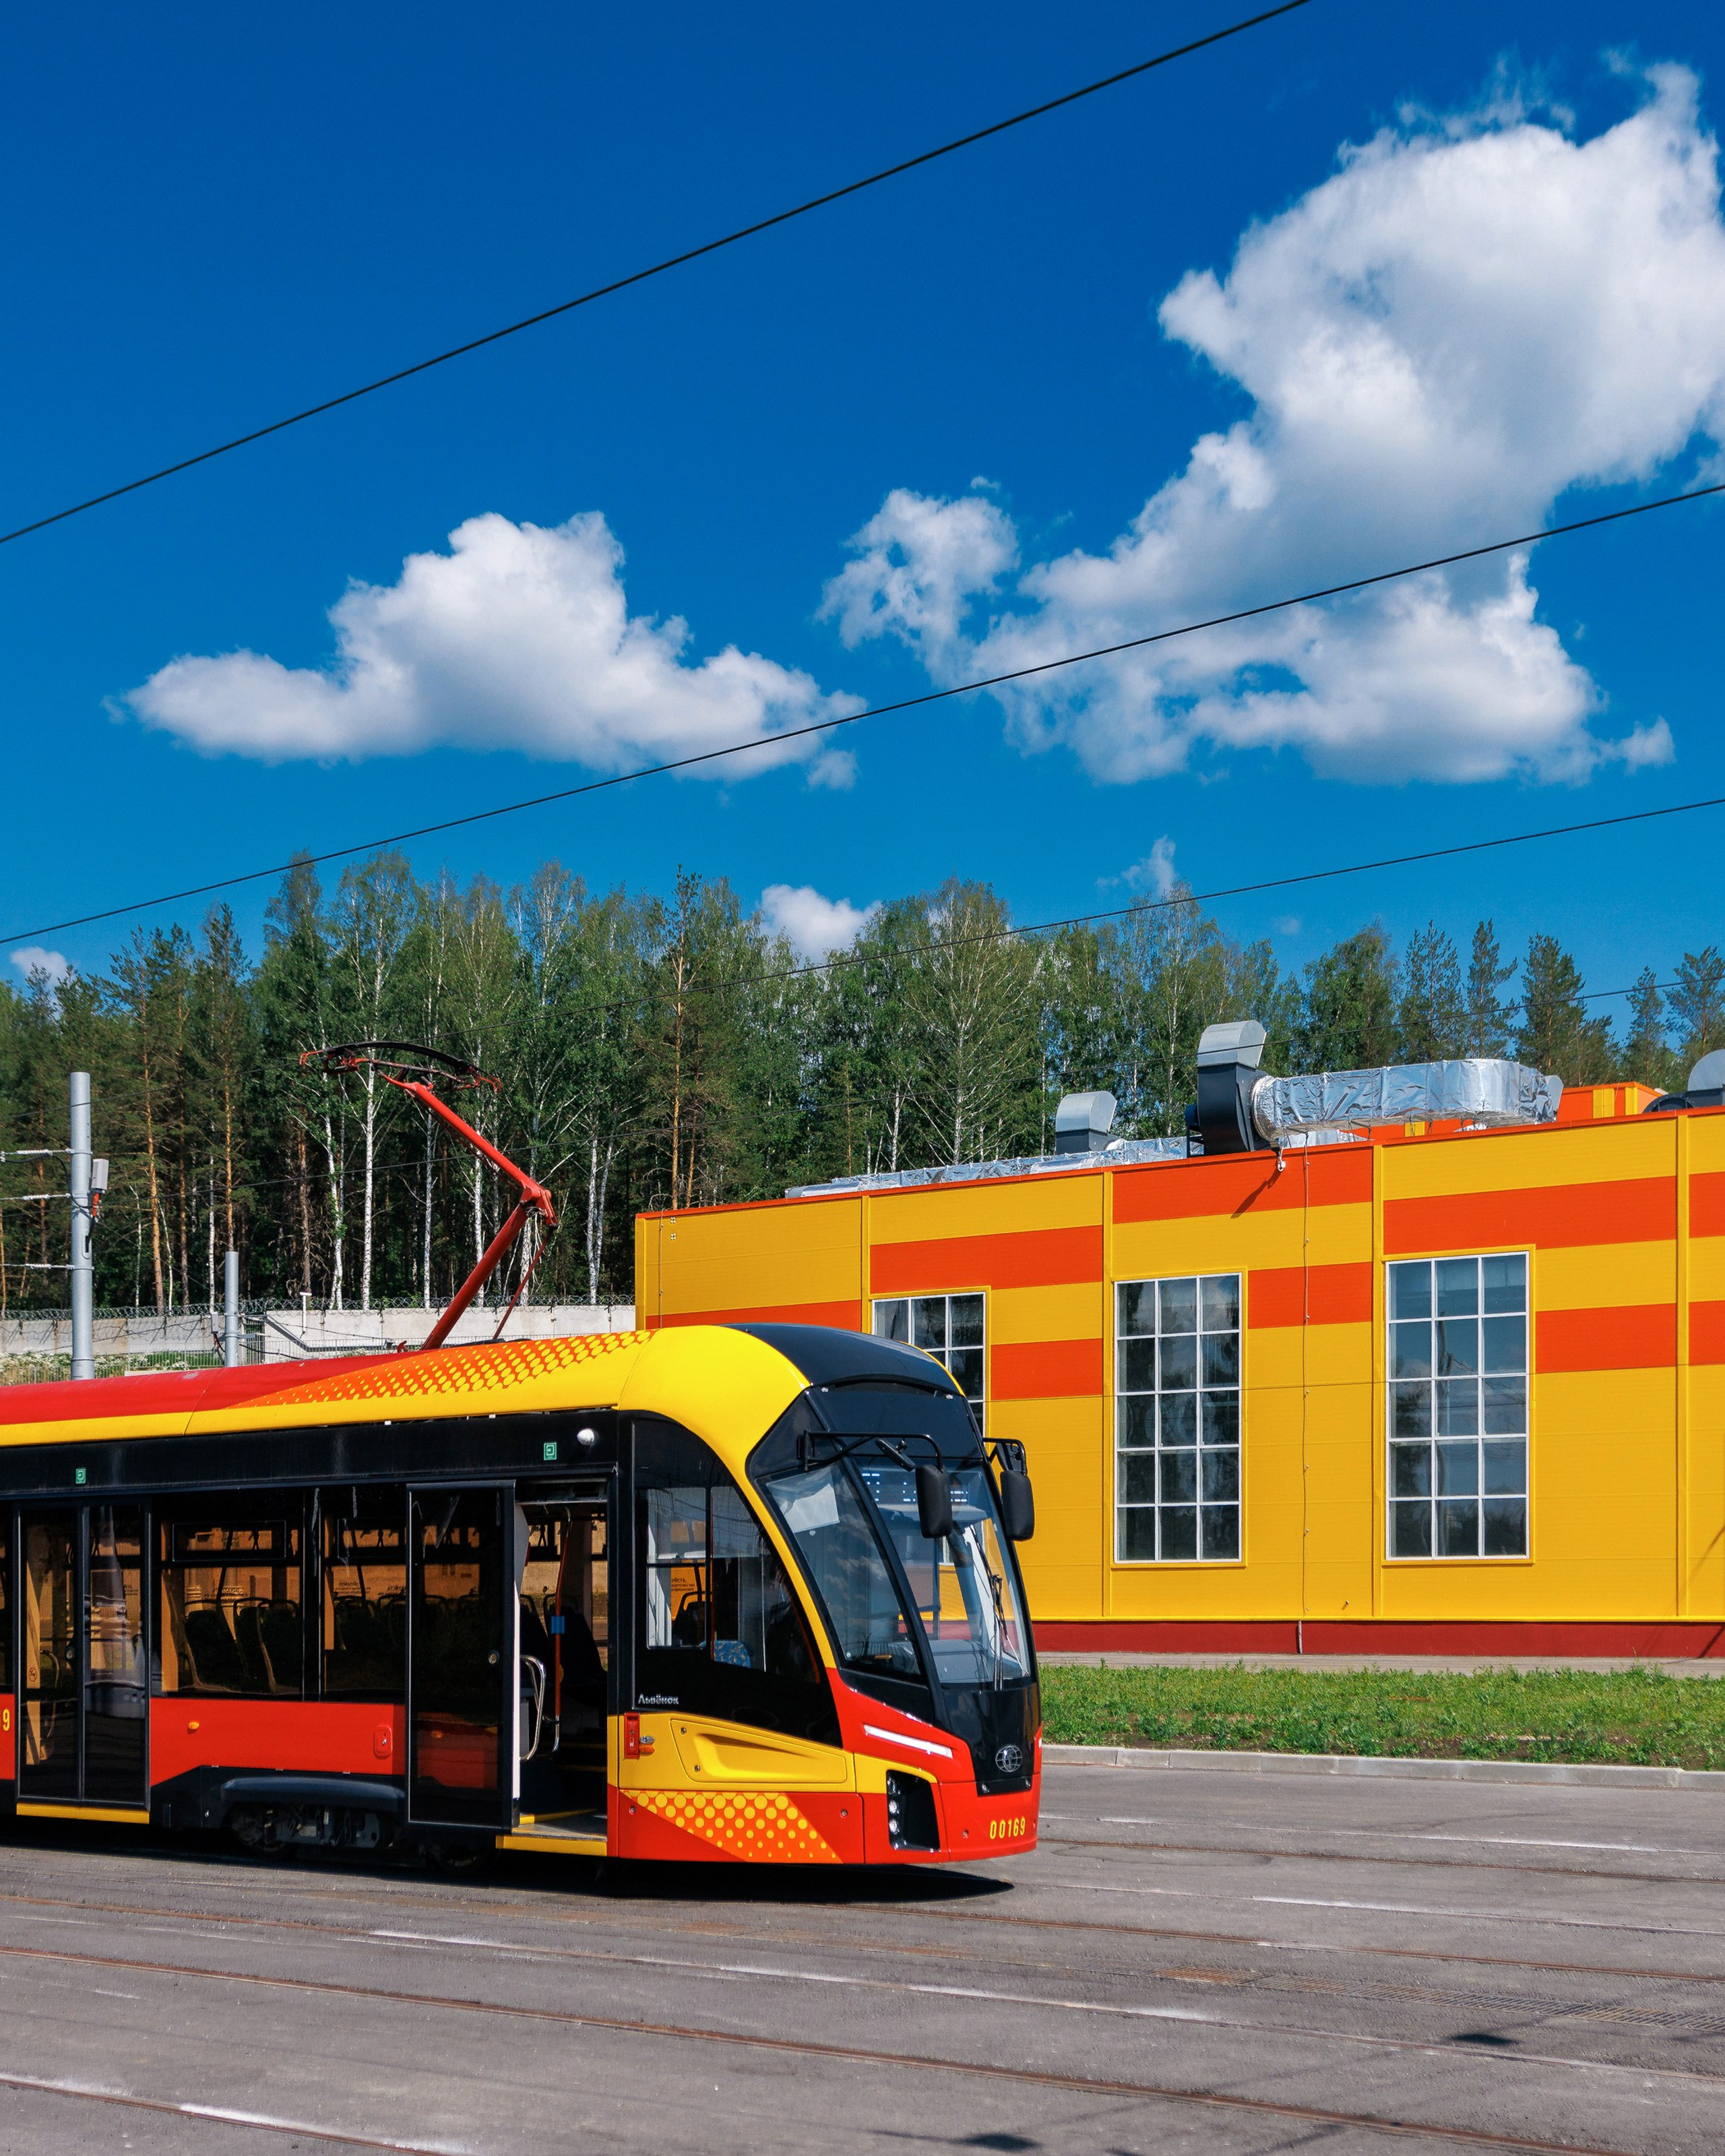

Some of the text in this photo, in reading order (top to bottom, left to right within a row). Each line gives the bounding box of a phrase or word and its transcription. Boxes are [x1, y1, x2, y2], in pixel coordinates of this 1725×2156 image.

[637, 1693, 679, 1705] Львёнок
[0, 1708, 10, 1732] 9
[989, 1816, 1026, 1840] 00169
